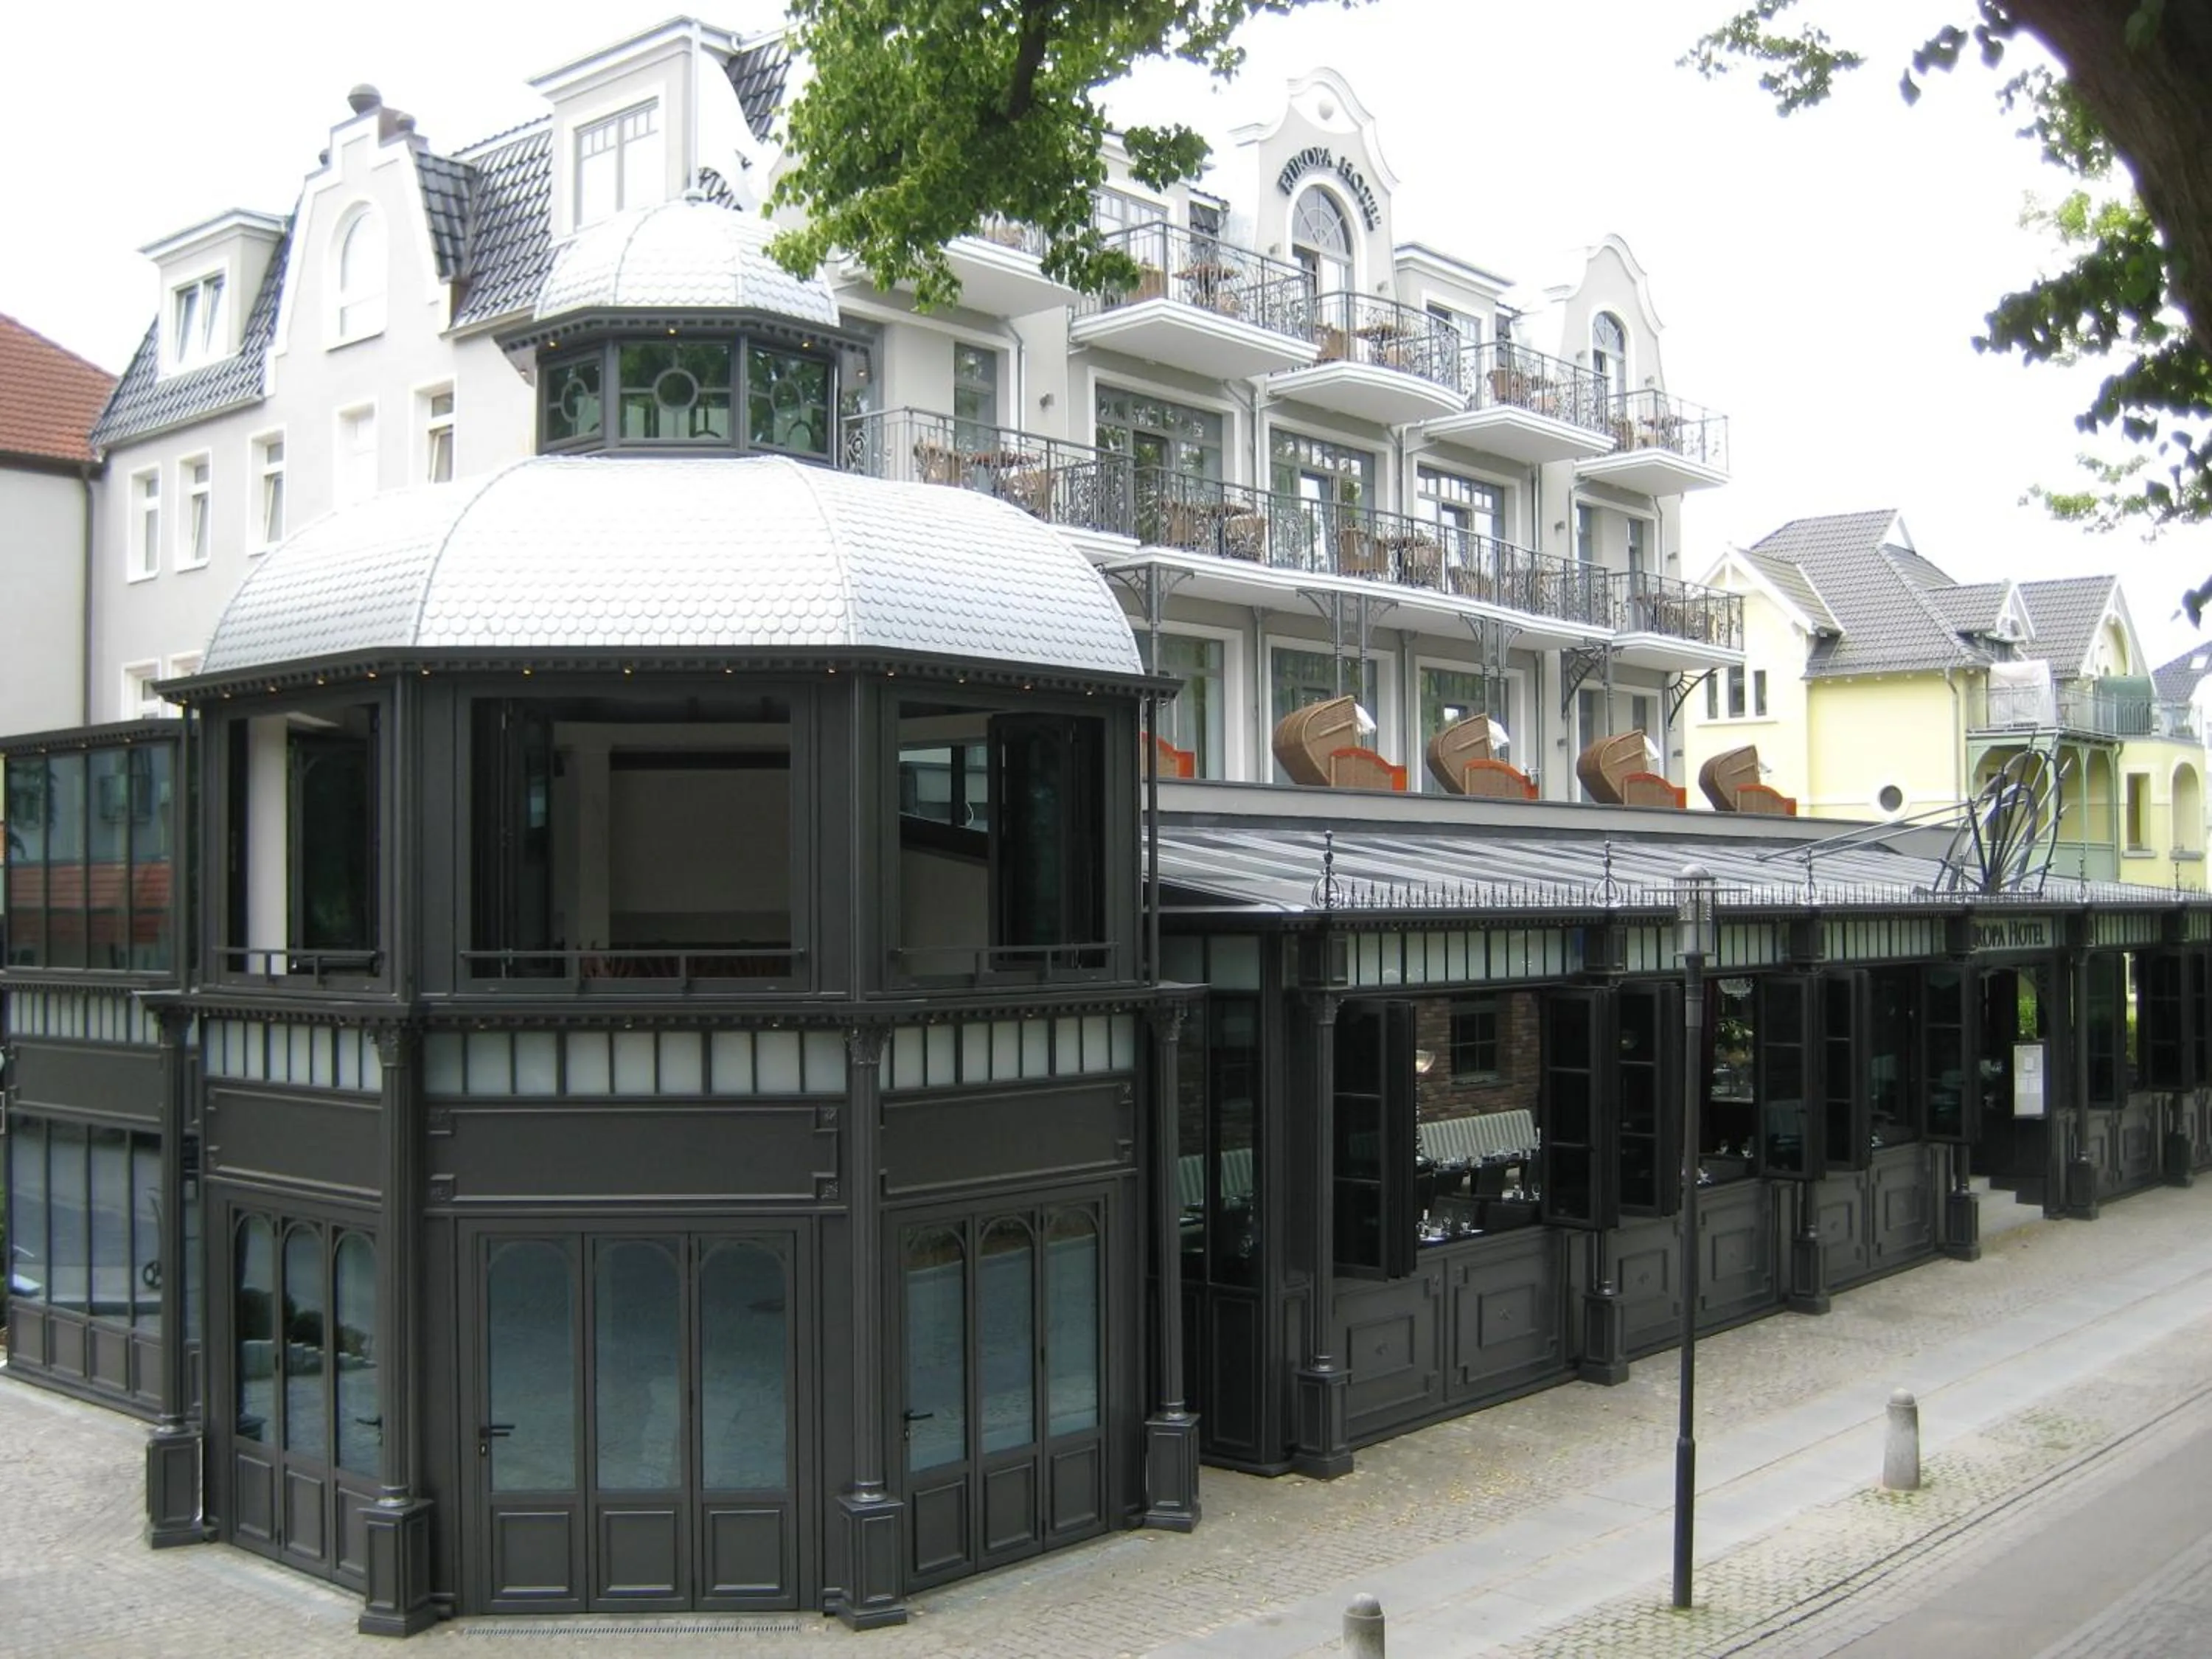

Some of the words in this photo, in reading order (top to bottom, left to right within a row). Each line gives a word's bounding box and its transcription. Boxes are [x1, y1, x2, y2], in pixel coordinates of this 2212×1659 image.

[1277, 147, 1333, 196] EUROPA
[1972, 923, 2006, 947] ROPA
[2008, 920, 2045, 947] HOTEL
